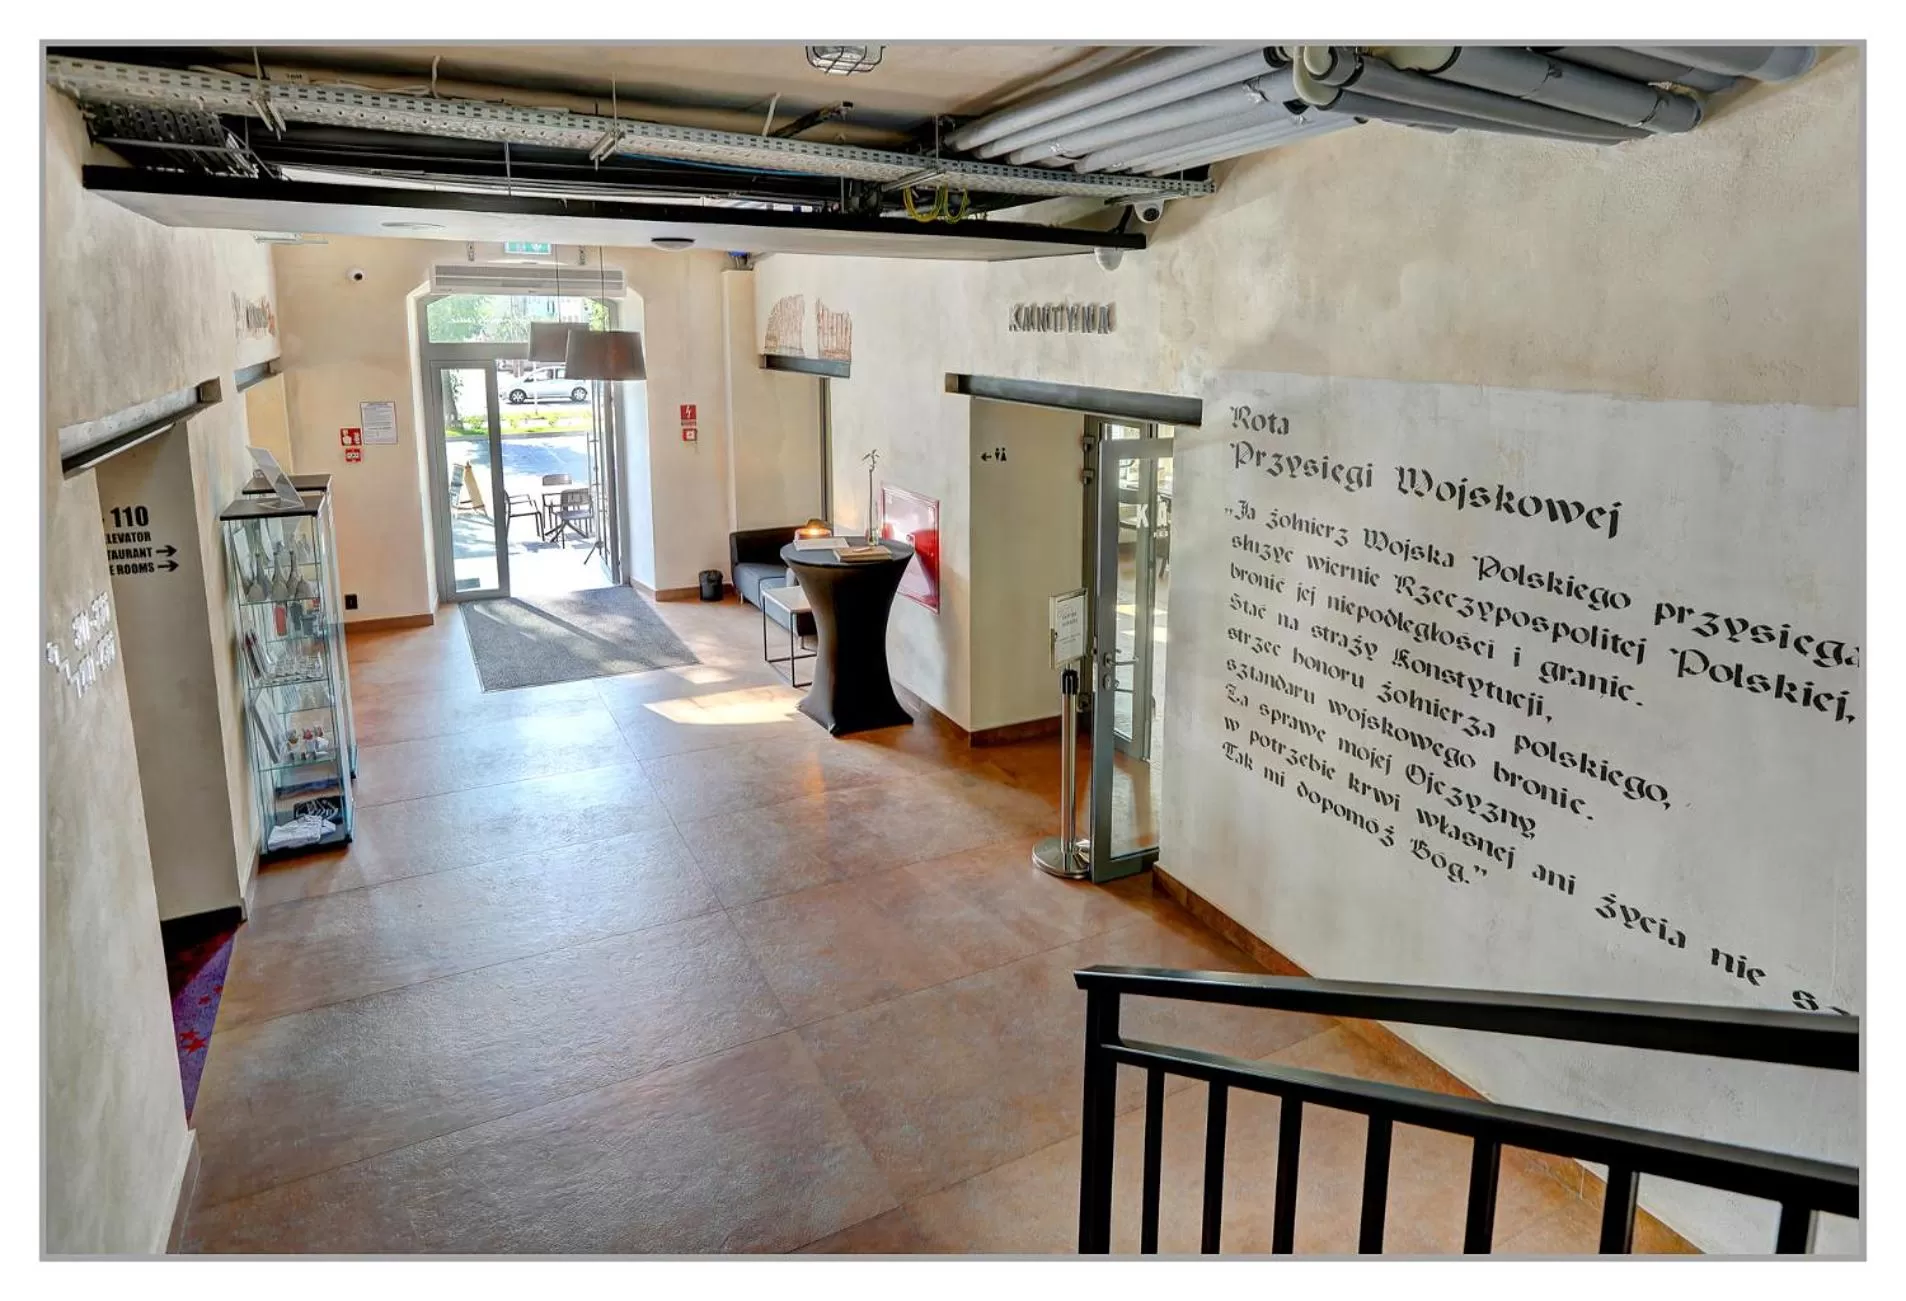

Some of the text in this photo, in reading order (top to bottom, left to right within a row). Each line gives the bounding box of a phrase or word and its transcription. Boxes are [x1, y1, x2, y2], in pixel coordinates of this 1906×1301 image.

[1230, 405, 1289, 435] Rota
[106, 531, 151, 544] LEVATOR
[110, 506, 149, 528] 110
[1394, 466, 1622, 538] Wojskowej
[107, 547, 152, 560] TAURANT
[116, 562, 154, 575] ROOMS
[1363, 528, 1454, 568] Wojska
[1472, 555, 1631, 611] Polskiego
[1278, 612, 1299, 631] na
[1311, 625, 1378, 661] straży
[1392, 648, 1552, 722] Konstytucji,
[1297, 582, 1316, 606] jej
[1328, 595, 1494, 659] niepodległości
[1514, 647, 1521, 667] i
[1538, 661, 1643, 706] granic.
[1307, 555, 1380, 587] wiernie
[1394, 574, 1647, 664] Rzeczypospolitej
[1669, 648, 1855, 723] Polskiej,
[1225, 683, 1248, 707] Za
[1338, 737, 1392, 775] mojej
[1226, 659, 1315, 704] sztandaru
[1328, 699, 1476, 768] wojskowego
[1227, 627, 1671, 810] strzec honoru żołnierza polskiego,
[1222, 741, 1253, 770] Tak
[1264, 766, 1285, 787] mi
[1224, 716, 1240, 732] w
[1250, 730, 1336, 780] potrzebie
[1348, 772, 1401, 812] krwi
[1416, 808, 1516, 869] własnej
[1532, 864, 1576, 895] ani
[1595, 893, 1687, 949] życia
[1711, 948, 1766, 986] nie
